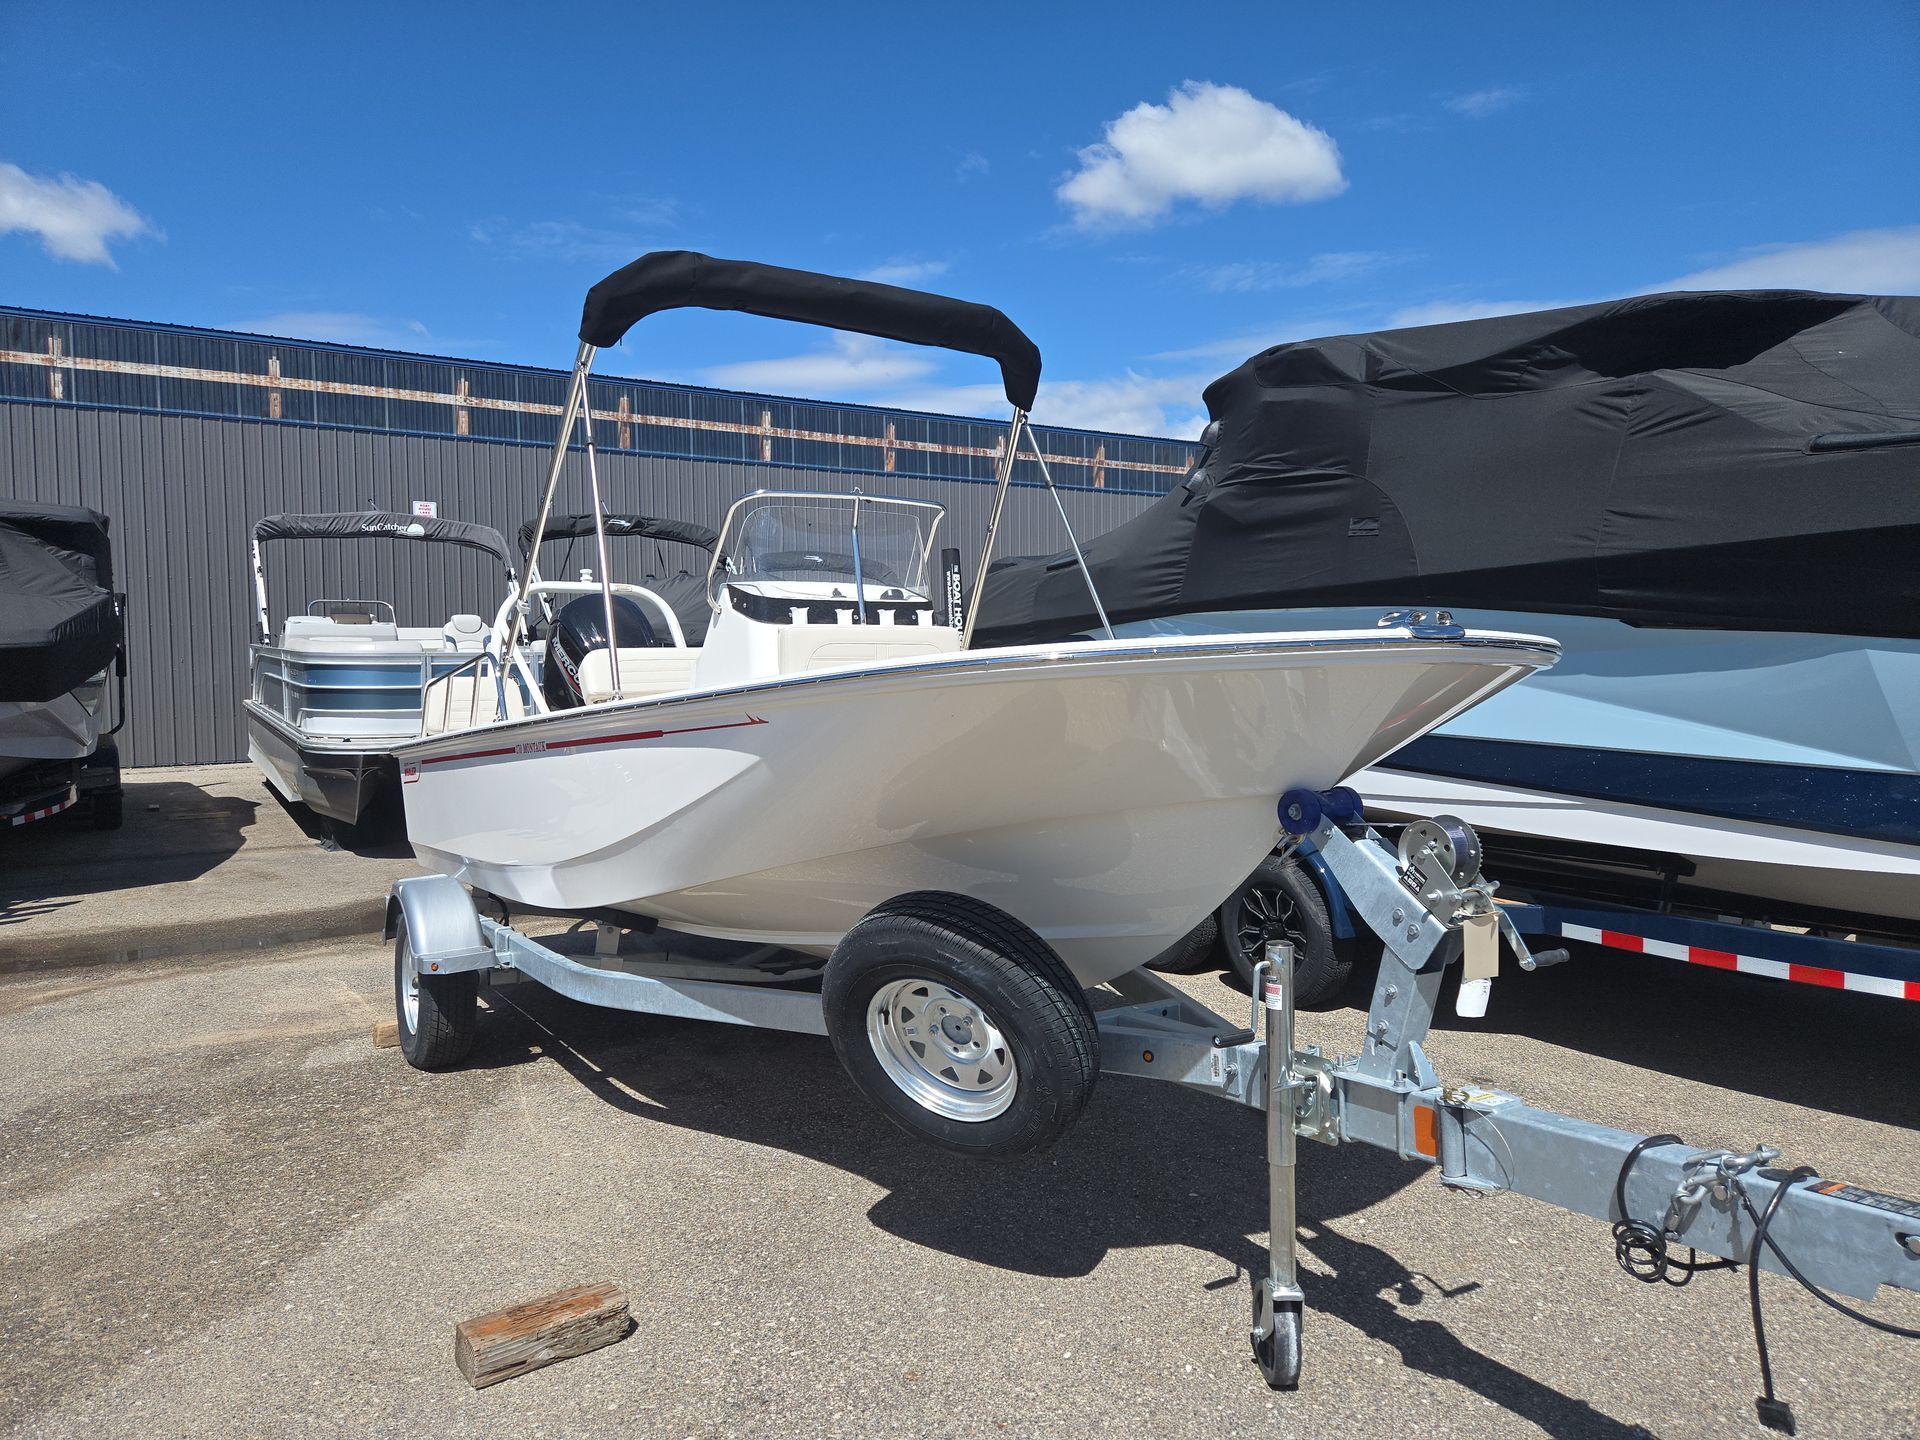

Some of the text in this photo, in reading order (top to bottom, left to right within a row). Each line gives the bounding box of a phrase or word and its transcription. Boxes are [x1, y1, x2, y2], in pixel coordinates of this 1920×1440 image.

[361, 523, 408, 533] SunCatcher
[952, 573, 962, 606] BOAT
[954, 607, 964, 643] HOU
[552, 636, 581, 685] MERCU
